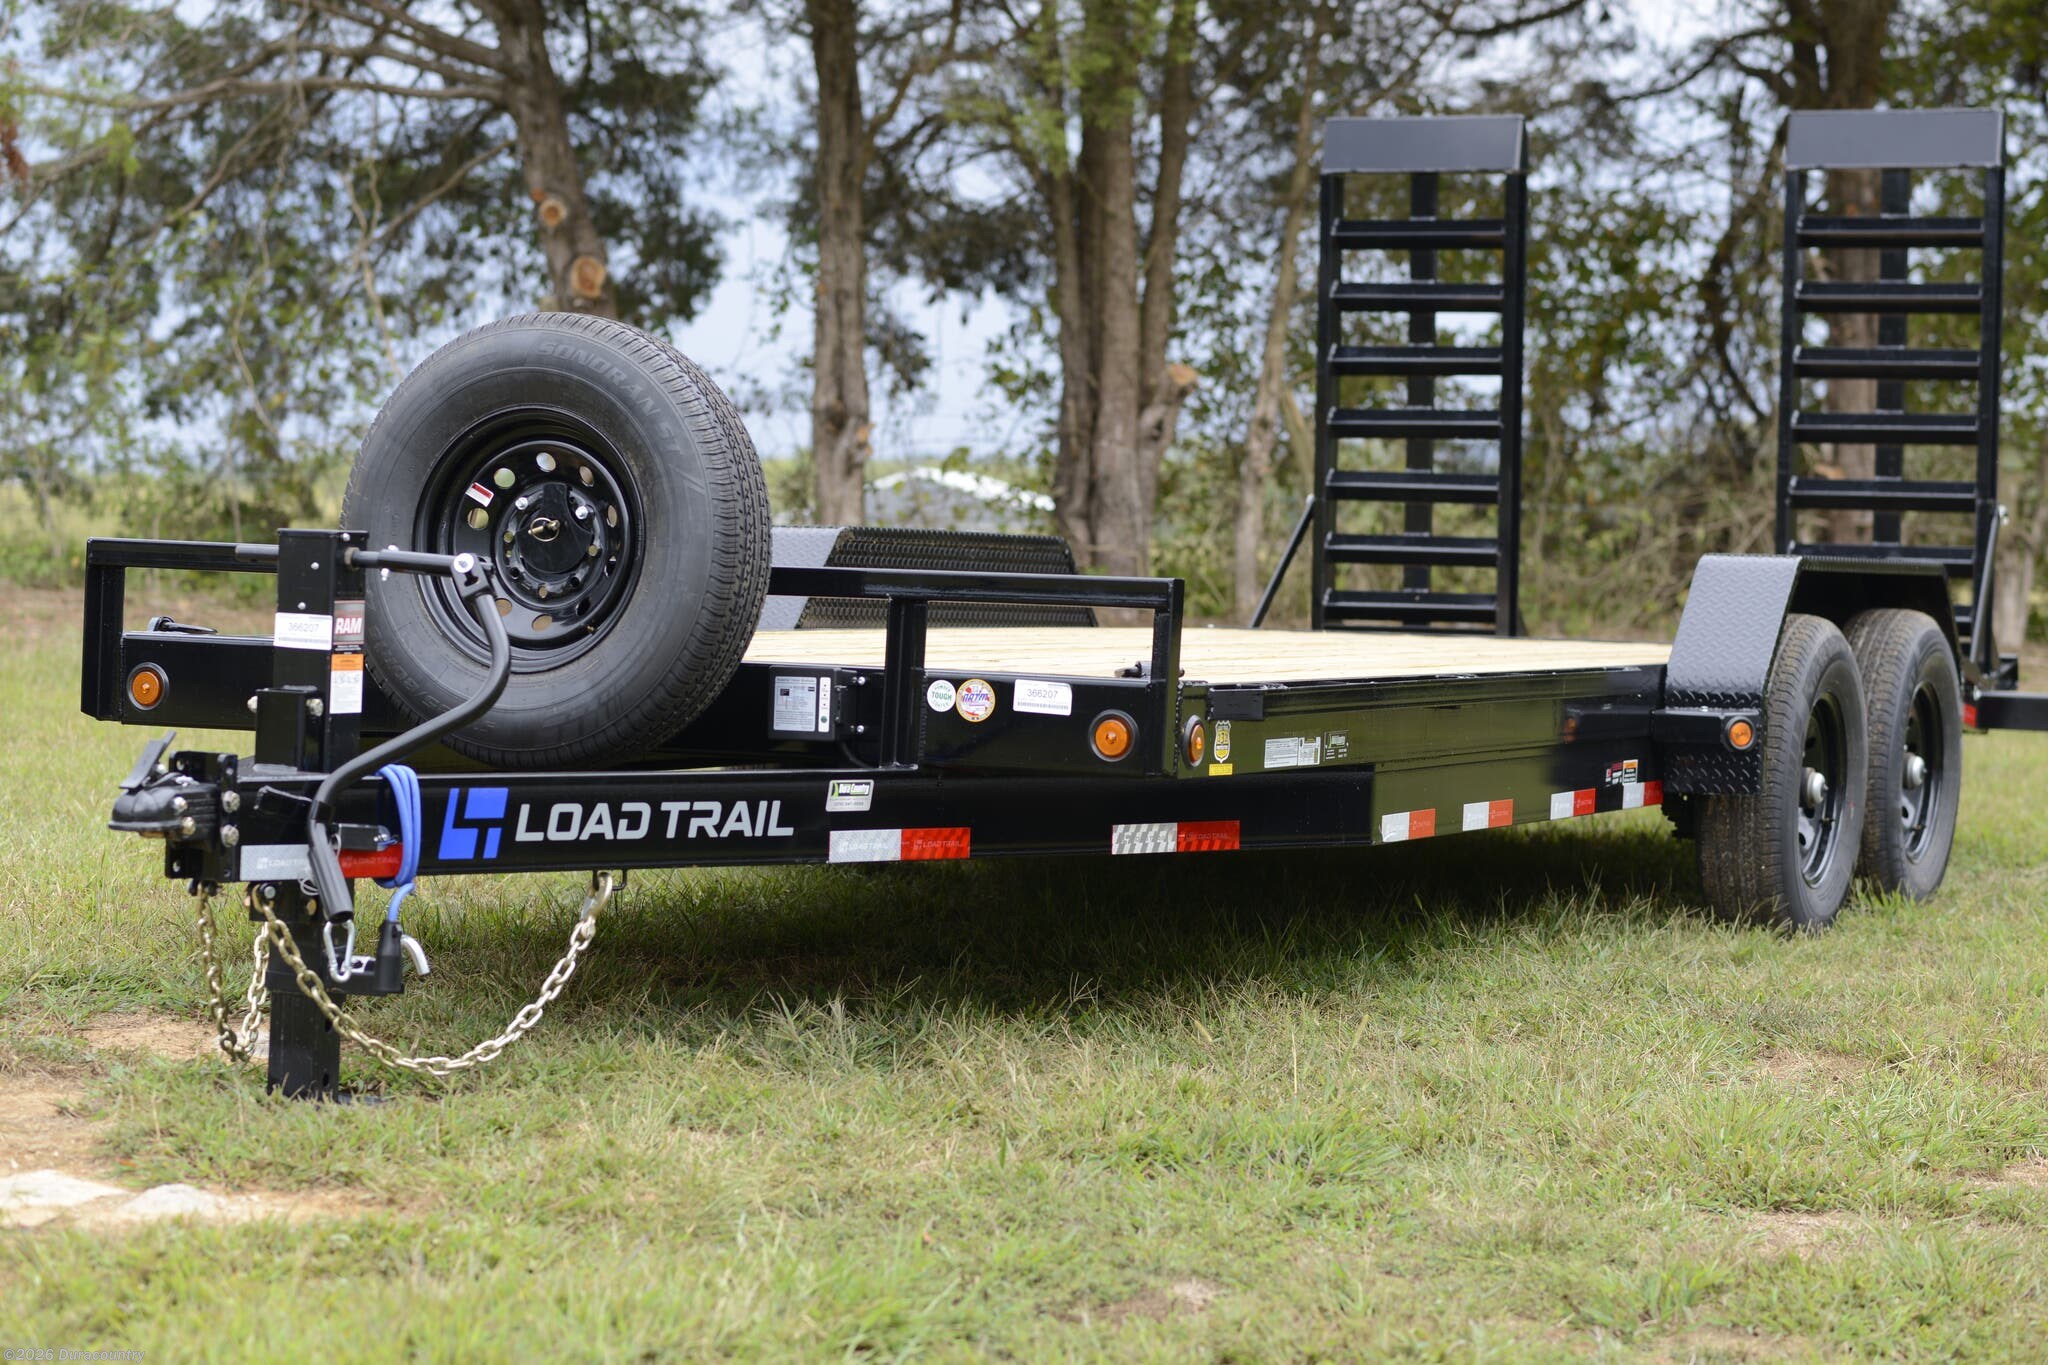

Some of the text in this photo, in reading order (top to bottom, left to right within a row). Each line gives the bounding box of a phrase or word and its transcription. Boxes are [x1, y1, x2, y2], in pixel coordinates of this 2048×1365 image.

[534, 342, 662, 417] SONORAN
[335, 617, 362, 634] RAM
[515, 800, 795, 842] LOAD TRAIL
